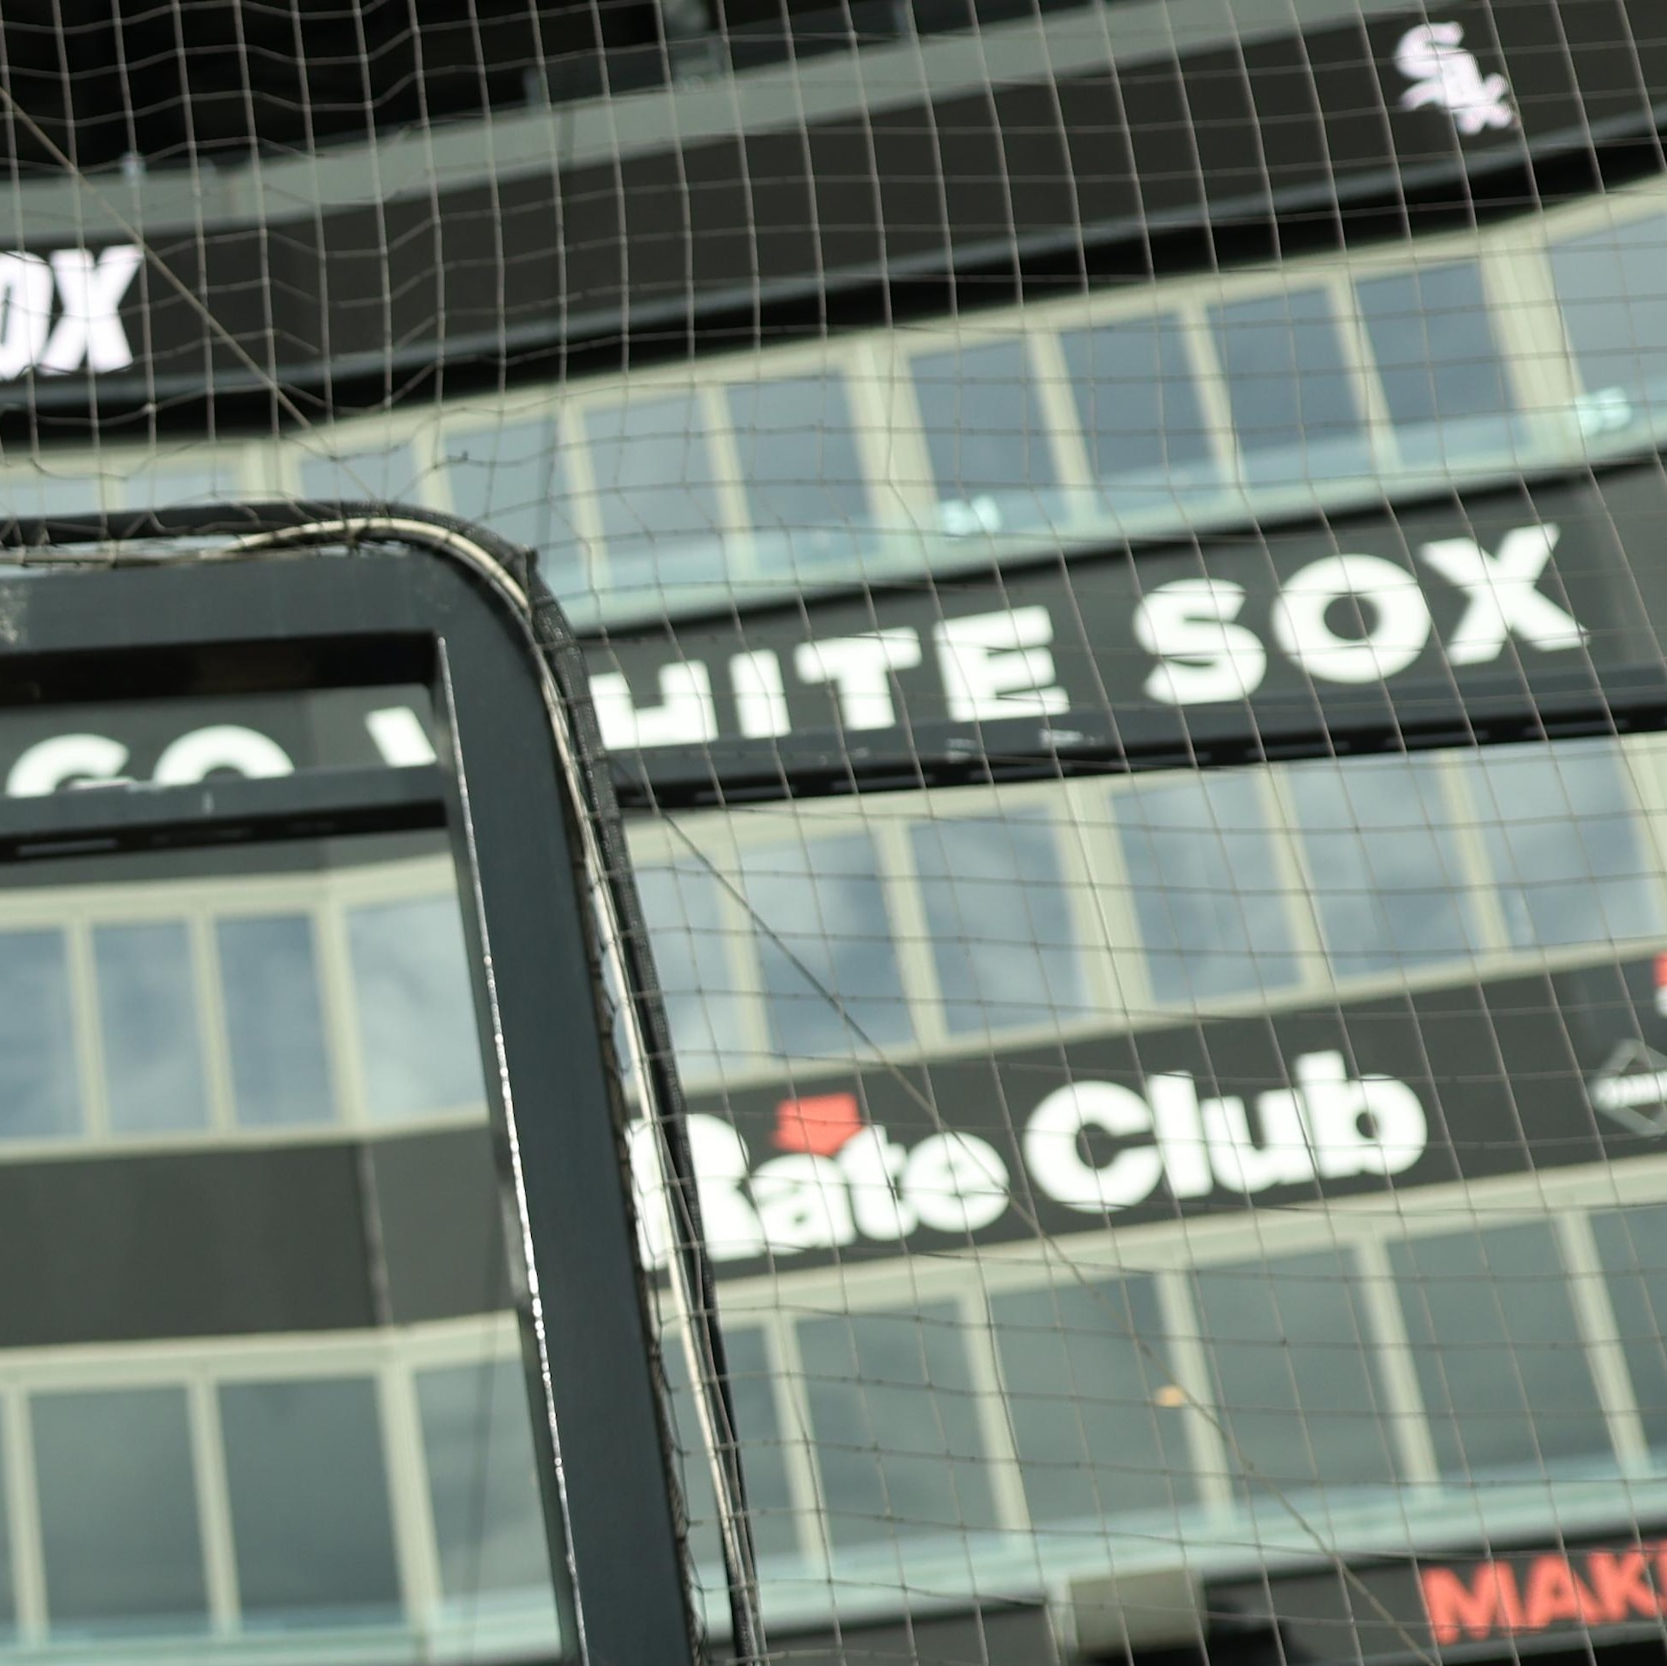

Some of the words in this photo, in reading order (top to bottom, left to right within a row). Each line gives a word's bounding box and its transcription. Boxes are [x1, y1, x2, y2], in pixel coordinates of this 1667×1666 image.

[367, 604, 1071, 767] HITE
[1131, 522, 1589, 706] SOX
[623, 1110, 1012, 1275] Rate
[1023, 1050, 1429, 1215] Club
[1421, 1538, 1667, 1647] MAK
